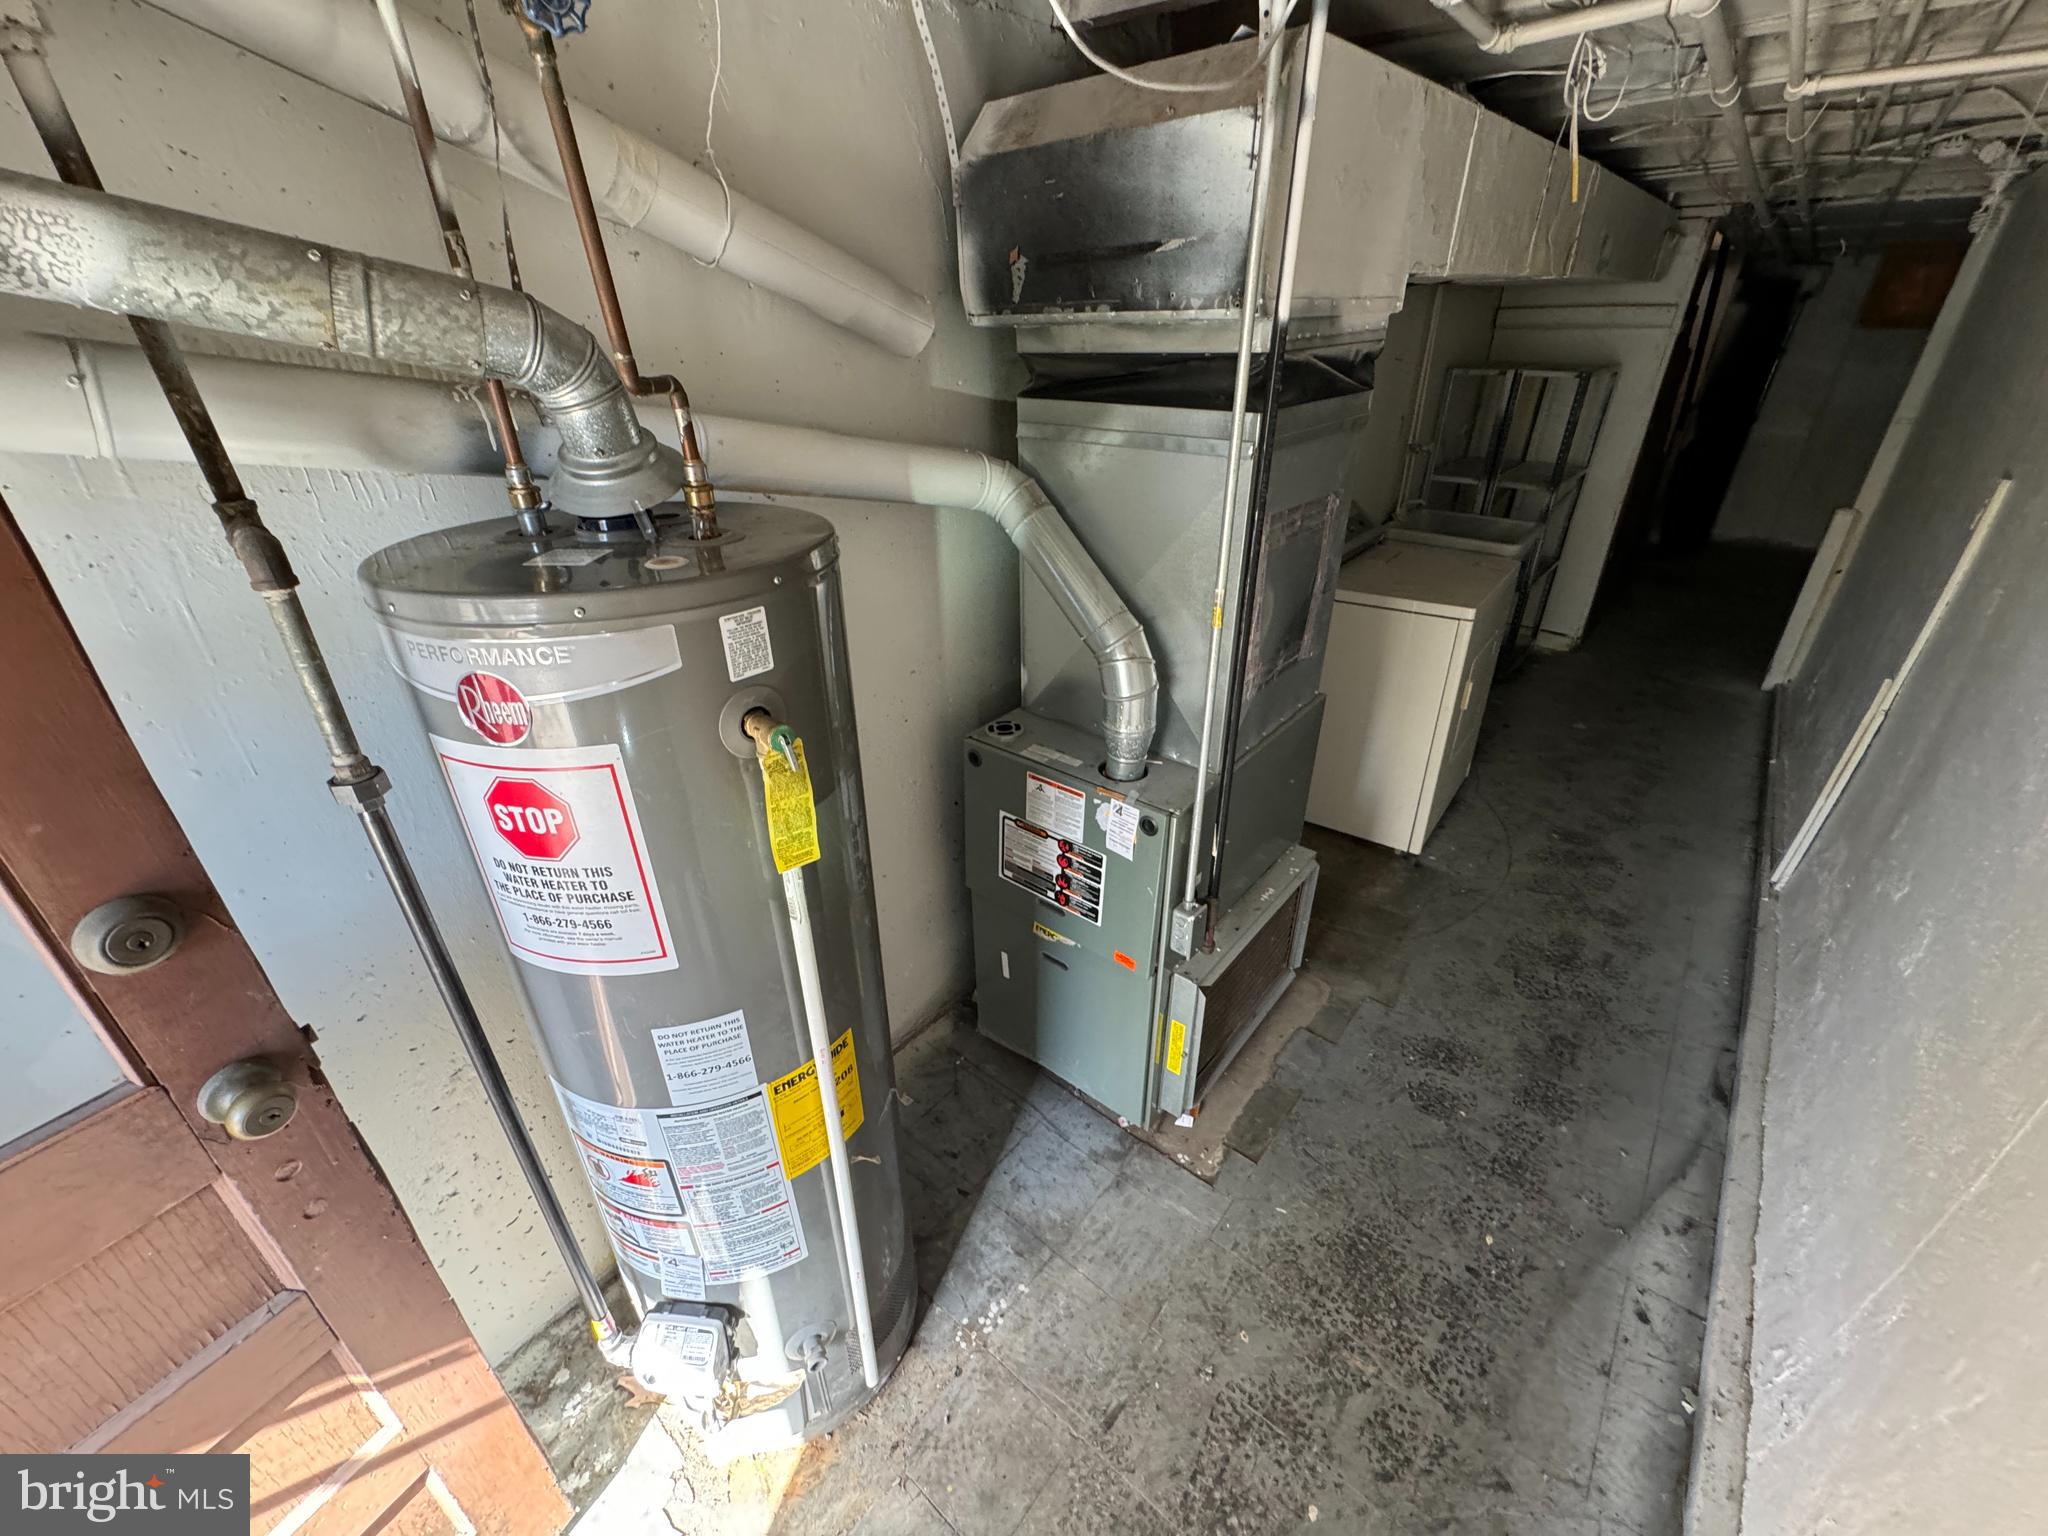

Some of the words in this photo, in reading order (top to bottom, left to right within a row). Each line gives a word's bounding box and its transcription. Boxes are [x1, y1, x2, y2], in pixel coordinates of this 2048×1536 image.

[459, 674, 528, 734] Rheem
[494, 804, 564, 835] STOP
[493, 858, 506, 870] DO
[510, 862, 529, 875] NOT
[531, 866, 579, 878] RETURN
[582, 866, 613, 878] THIS
[494, 880, 512, 894] THE
[514, 887, 547, 902] PLACE
[548, 892, 563, 903] OF
[566, 891, 635, 904] PURCHASE
[502, 872, 539, 888] WATER
[542, 878, 588, 891] HEATER
[590, 880, 608, 891] TO
[523, 912, 613, 930] 1-866-279-4566
[658, 1040, 685, 1048] WATER
[686, 1033, 716, 1044] HEATER
[729, 1024, 744, 1034] THE
[672, 1031, 688, 1039] NOT
[690, 1023, 722, 1035] RETURN
[724, 1018, 741, 1027] THIS
[664, 1048, 688, 1056] PLACE
[701, 1033, 742, 1049] PURCHASE
[666, 1055, 752, 1080] 1-866-279-4566
